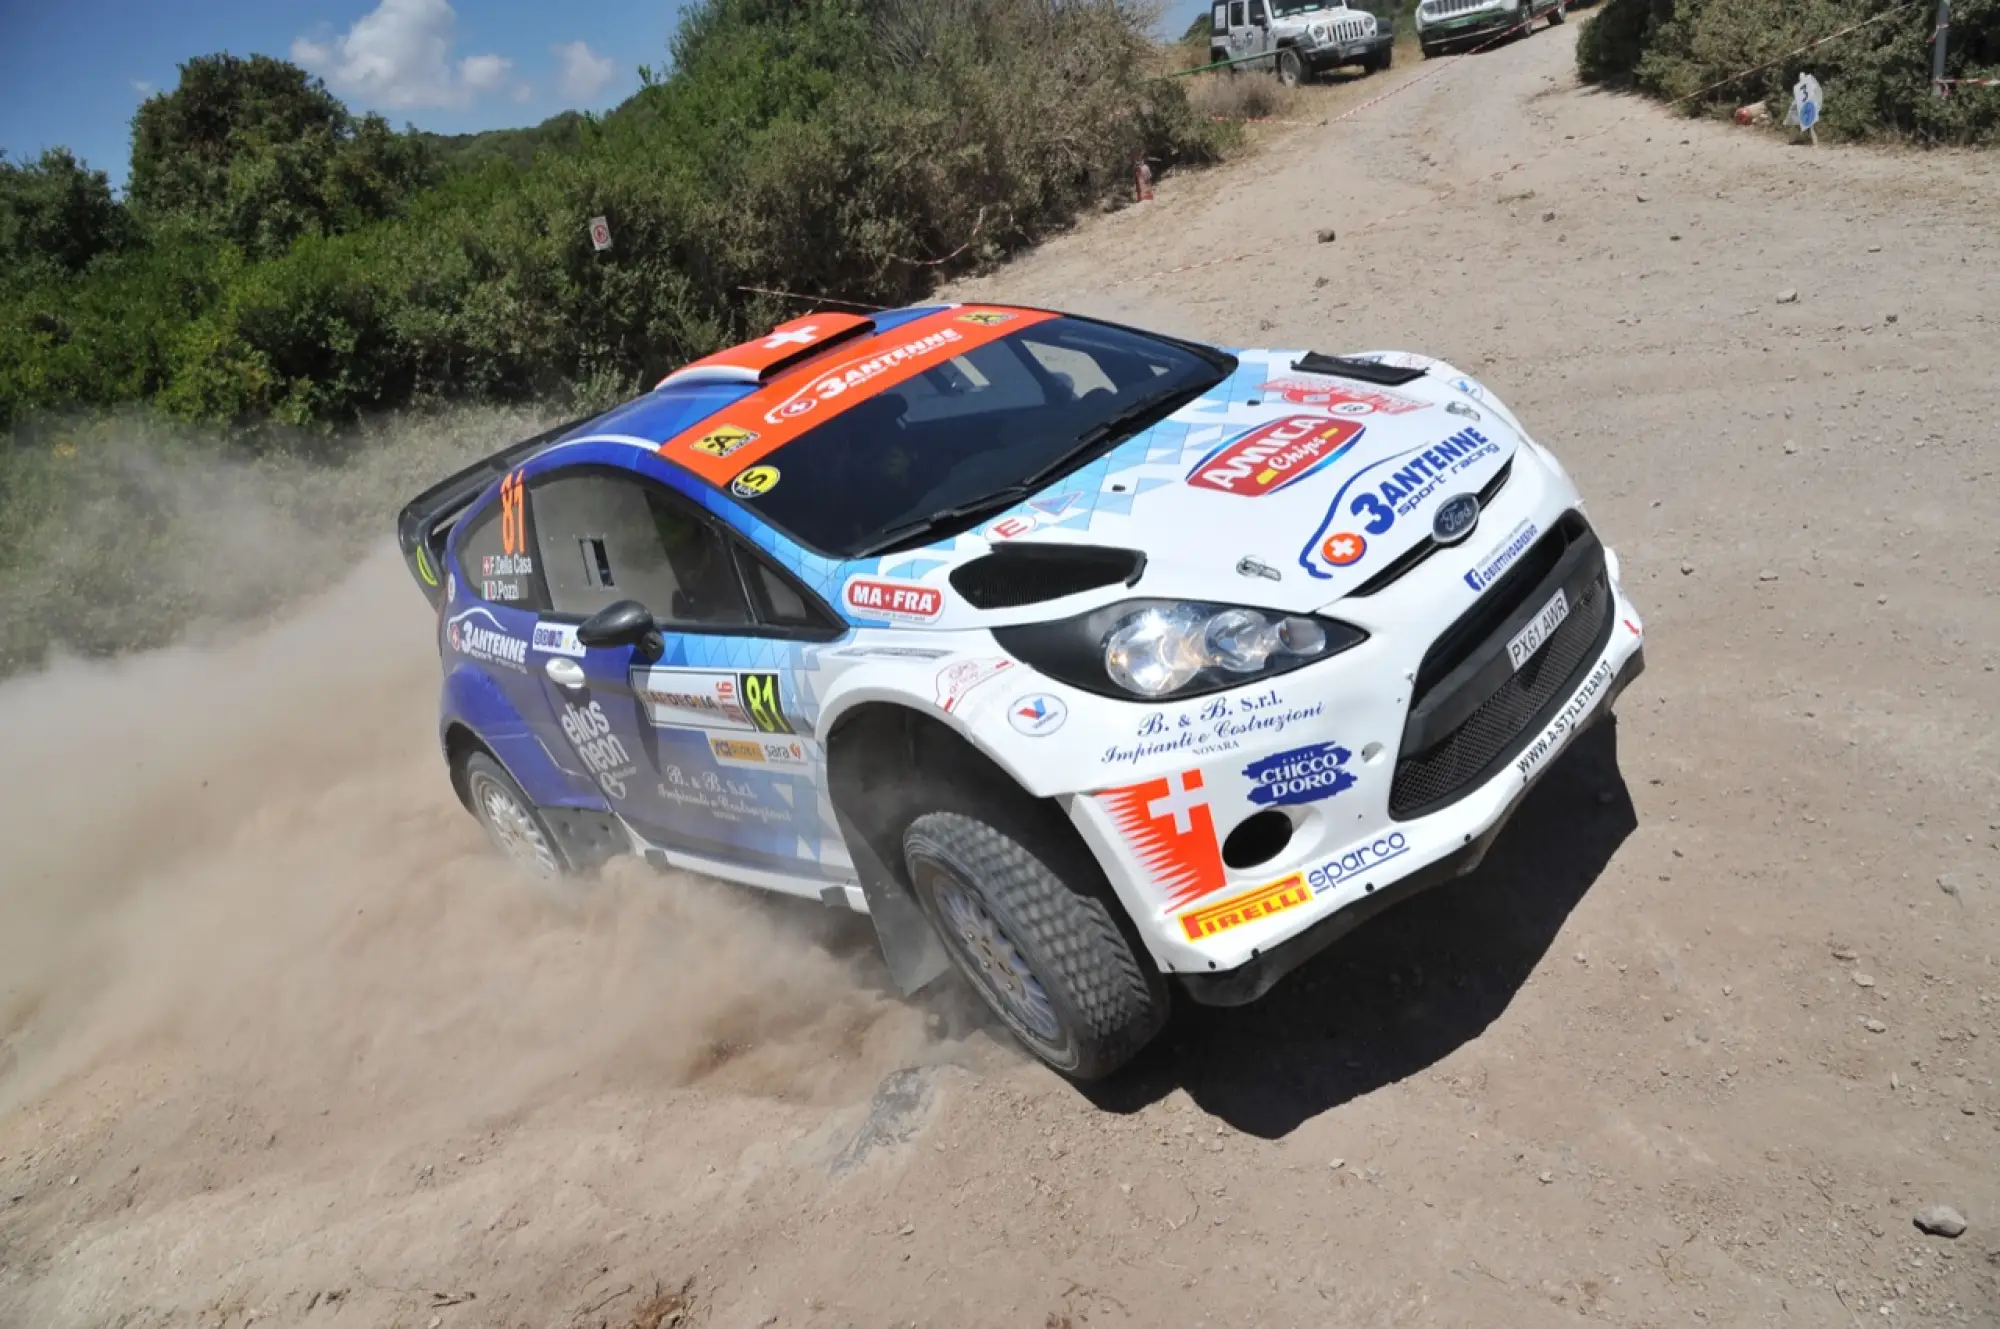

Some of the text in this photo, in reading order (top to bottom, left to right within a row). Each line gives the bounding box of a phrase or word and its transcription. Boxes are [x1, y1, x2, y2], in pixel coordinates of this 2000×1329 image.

[1202, 418, 1329, 489] AMICA
[1267, 436, 1327, 470] Chips
[1397, 442, 1500, 517] sport racing
[500, 469, 526, 555] 81
[1440, 498, 1473, 532] Ford
[747, 674, 791, 732] 81
[1241, 690, 1283, 712] S.r.l.
[1101, 731, 1193, 764] Impianti
[1213, 701, 1325, 739] Costruzioni
[1191, 739, 1240, 756] NOVARA
[1260, 752, 1339, 785] CHICCO
[1307, 831, 1406, 889] sparco
[1180, 874, 1309, 938] PIRELLI
